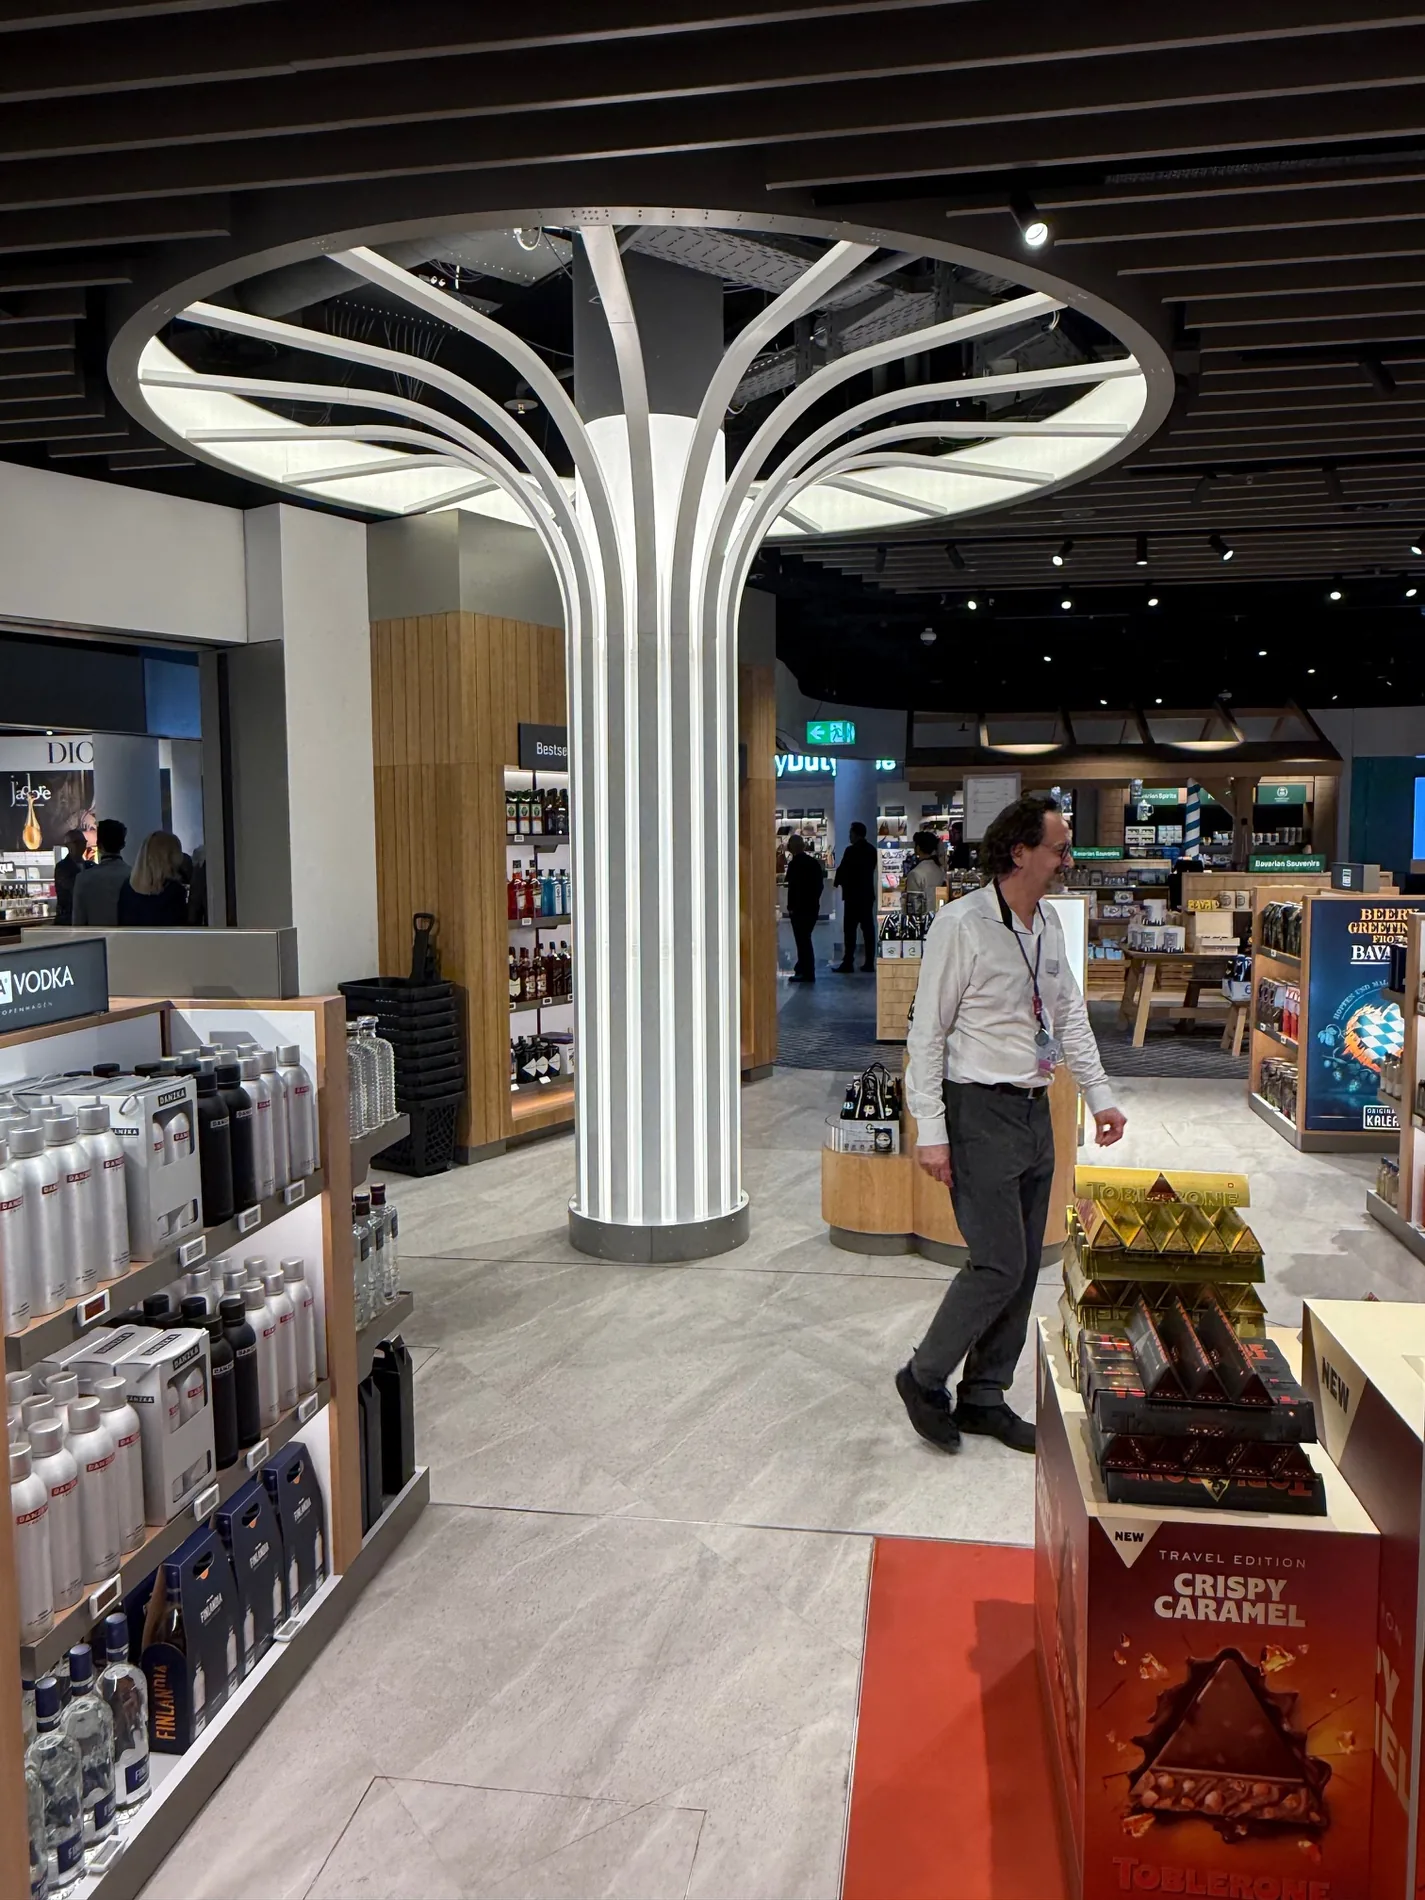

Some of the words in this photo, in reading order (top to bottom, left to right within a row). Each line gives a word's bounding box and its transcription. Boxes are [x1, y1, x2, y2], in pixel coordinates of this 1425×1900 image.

[13, 965, 75, 996] VODKA
[112, 1128, 139, 1136] ANZKA
[1321, 1355, 1350, 1415] NEW
[1115, 1531, 1145, 1543] NEW
[1159, 1550, 1225, 1565] TRAVEL
[1233, 1555, 1306, 1569] EDITION
[1173, 1572, 1288, 1602] CRISPY
[1154, 1595, 1307, 1628] CARAMEL
[153, 1664, 176, 1740] FINLANDIA
[1112, 1856, 1331, 1900] TOBLERONE
